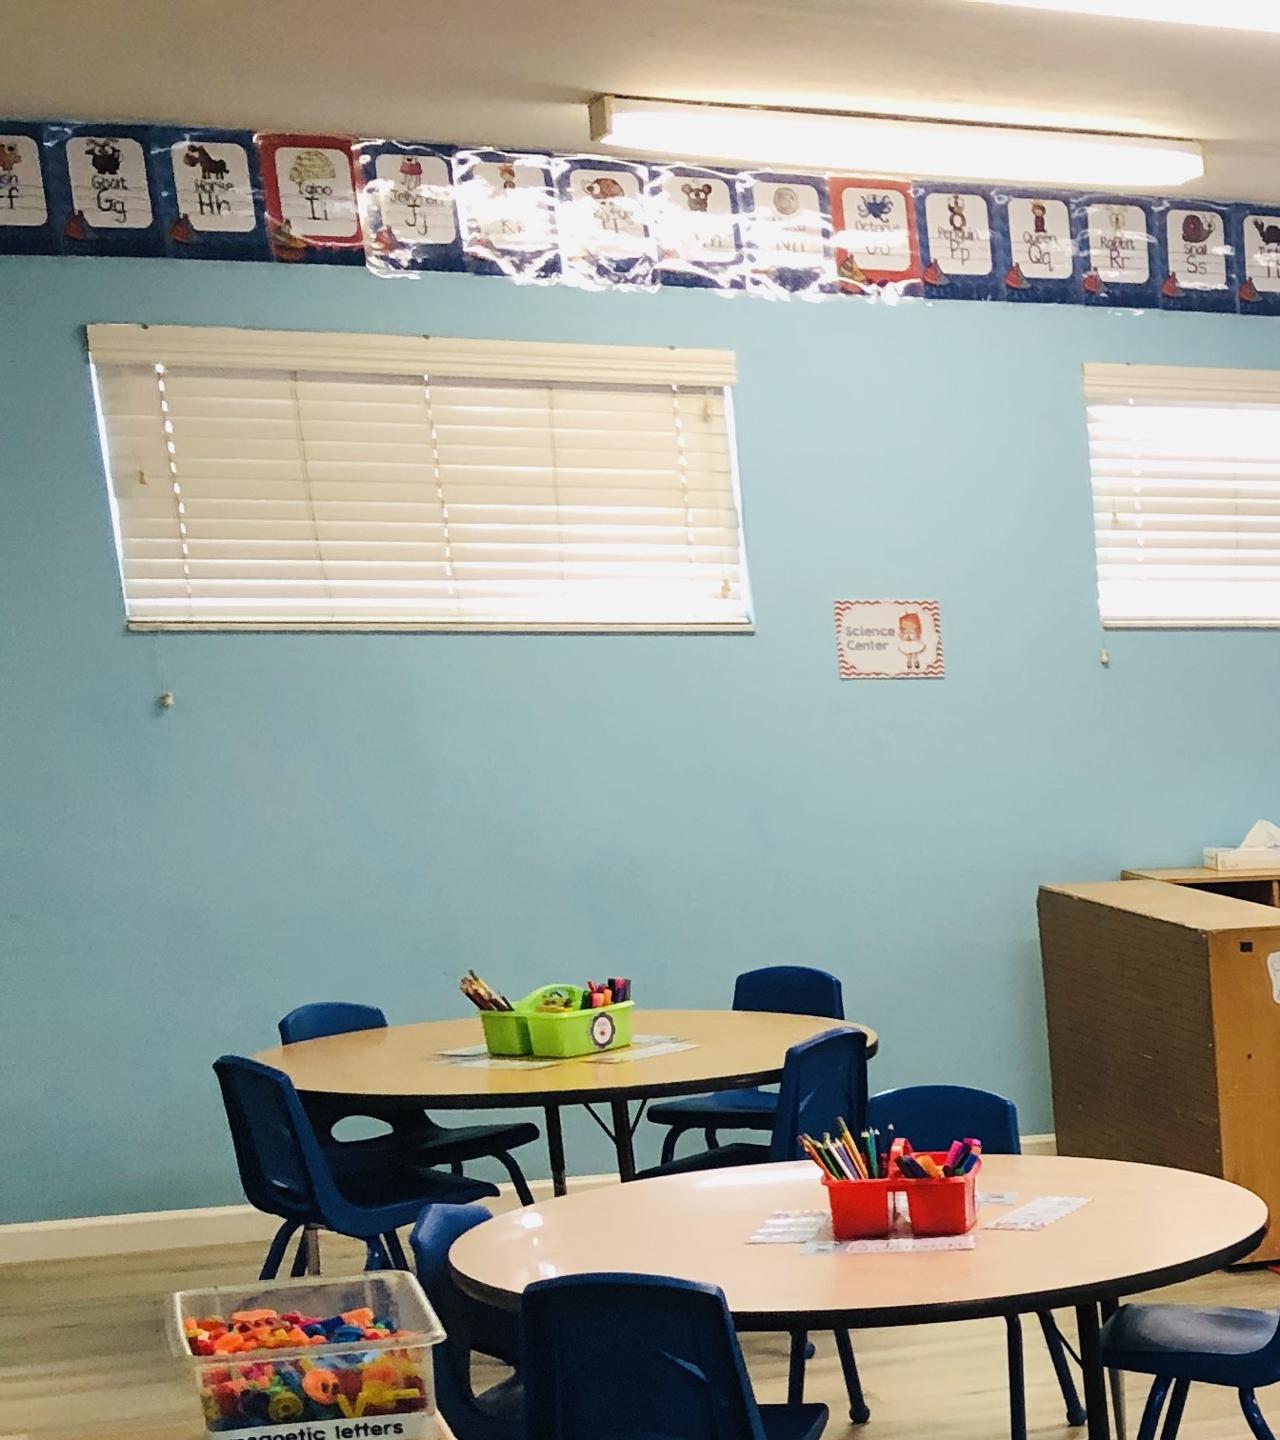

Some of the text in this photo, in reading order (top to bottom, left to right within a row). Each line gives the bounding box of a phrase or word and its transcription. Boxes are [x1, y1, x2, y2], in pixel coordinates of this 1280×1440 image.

[97, 189, 127, 223] Gg
[199, 193, 231, 216] Hh
[950, 239, 971, 265] Pp
[1027, 245, 1054, 272] Qq
[1109, 250, 1131, 270] Rr
[1186, 255, 1208, 274] Ss
[845, 625, 896, 638] Science
[846, 639, 889, 652] Center
[335, 1422, 404, 1440] letters
